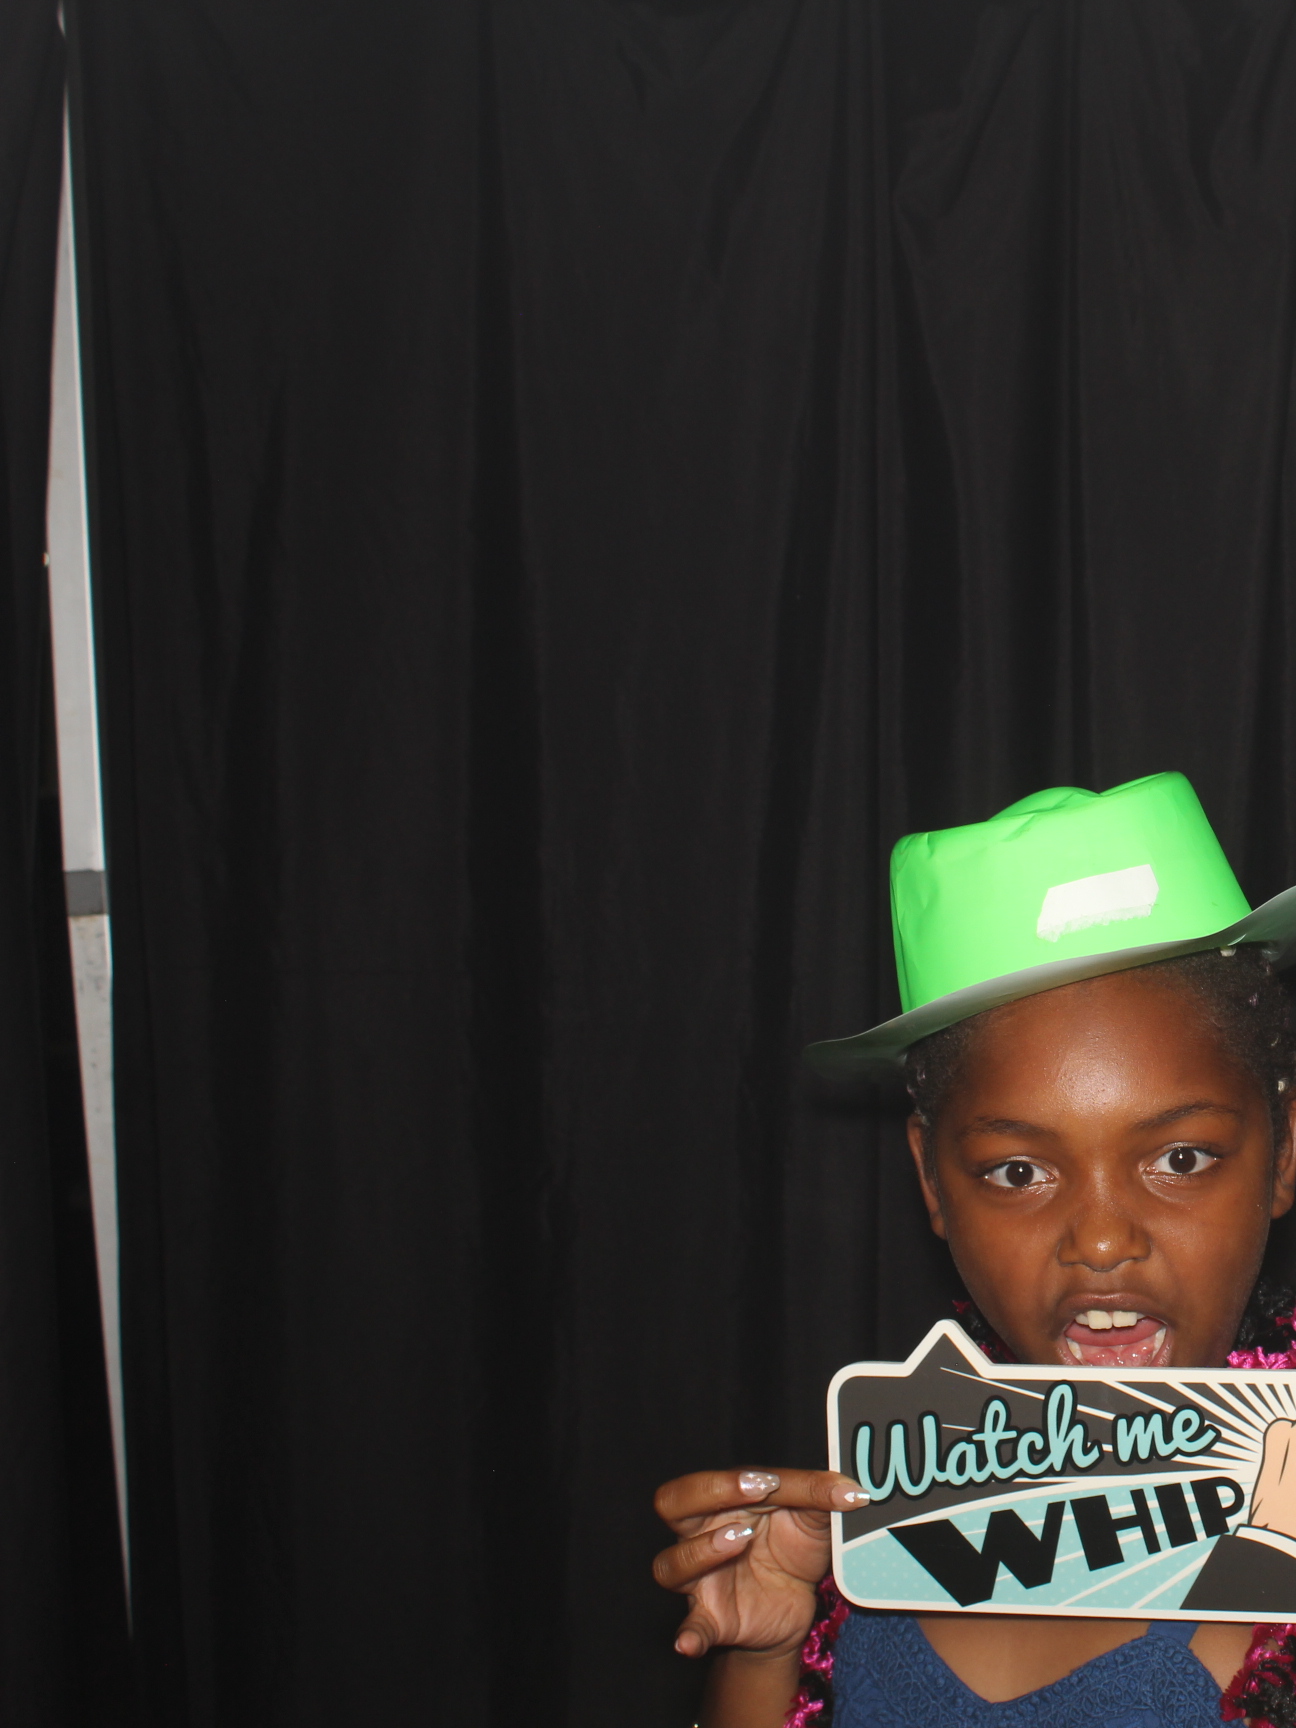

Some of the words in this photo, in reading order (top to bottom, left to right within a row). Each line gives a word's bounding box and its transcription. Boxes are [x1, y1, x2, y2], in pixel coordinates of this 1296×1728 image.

[855, 1382, 1100, 1502] Watch
[1115, 1408, 1217, 1461] me
[886, 1476, 1245, 1608] WHIP
